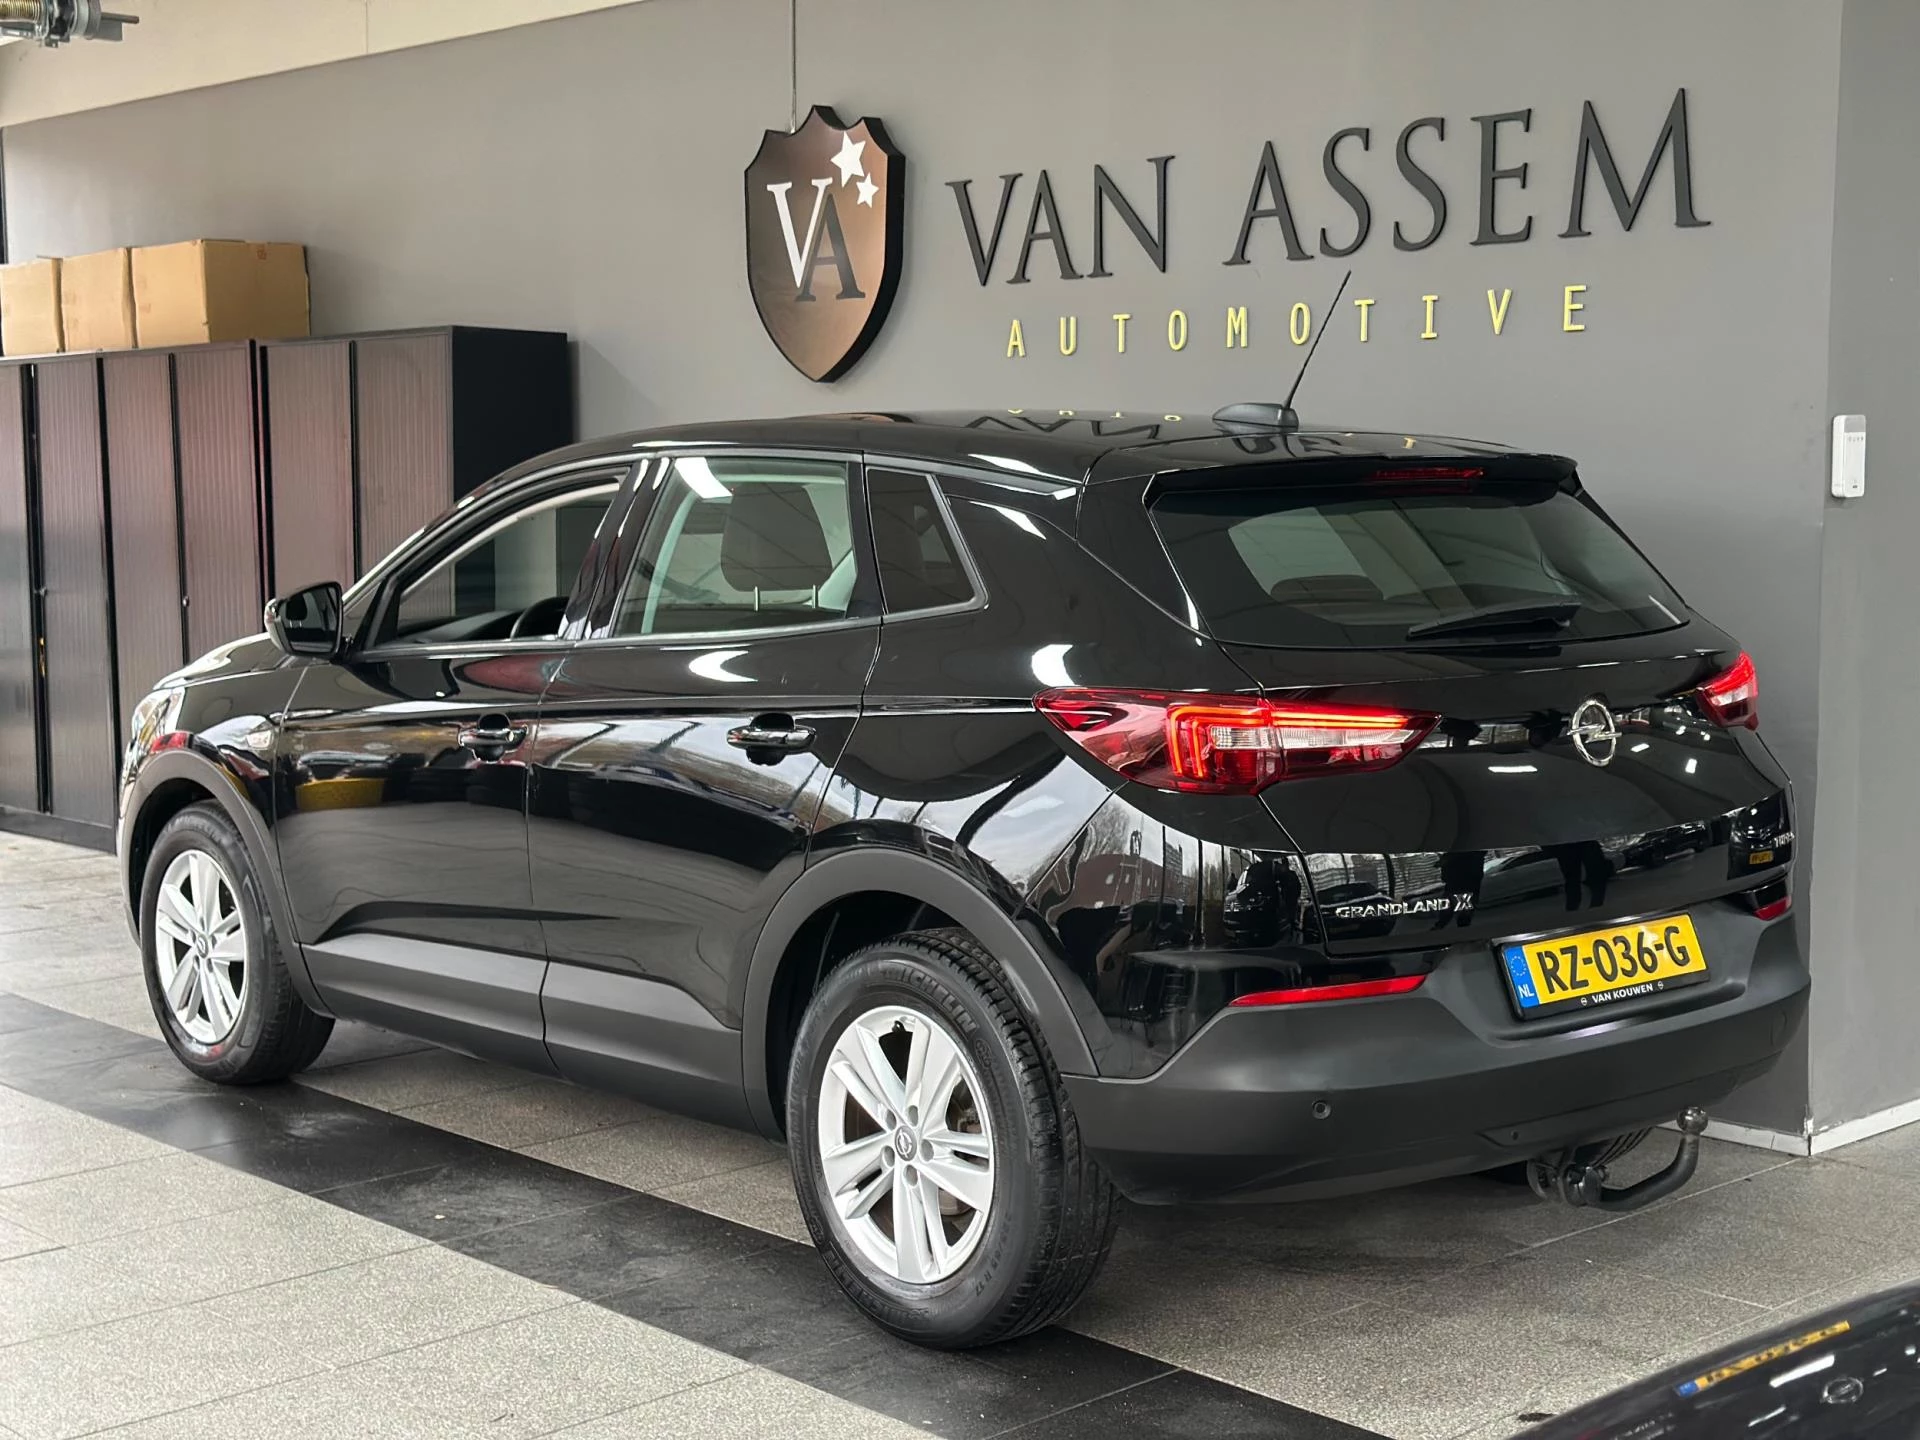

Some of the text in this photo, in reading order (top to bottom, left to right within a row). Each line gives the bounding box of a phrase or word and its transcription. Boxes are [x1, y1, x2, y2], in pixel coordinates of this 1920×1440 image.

[945, 87, 1711, 287] VAN ASSEM
[767, 177, 866, 301] VA
[1006, 284, 1587, 358] AUTOMOTIVE
[1335, 892, 1474, 919] GRANDLAND X
[1518, 984, 1535, 999] NL
[1536, 925, 1691, 994] RZ-036-G
[1592, 983, 1654, 1004] VAN KOUWEN
[884, 962, 977, 1033] MICHELIN
